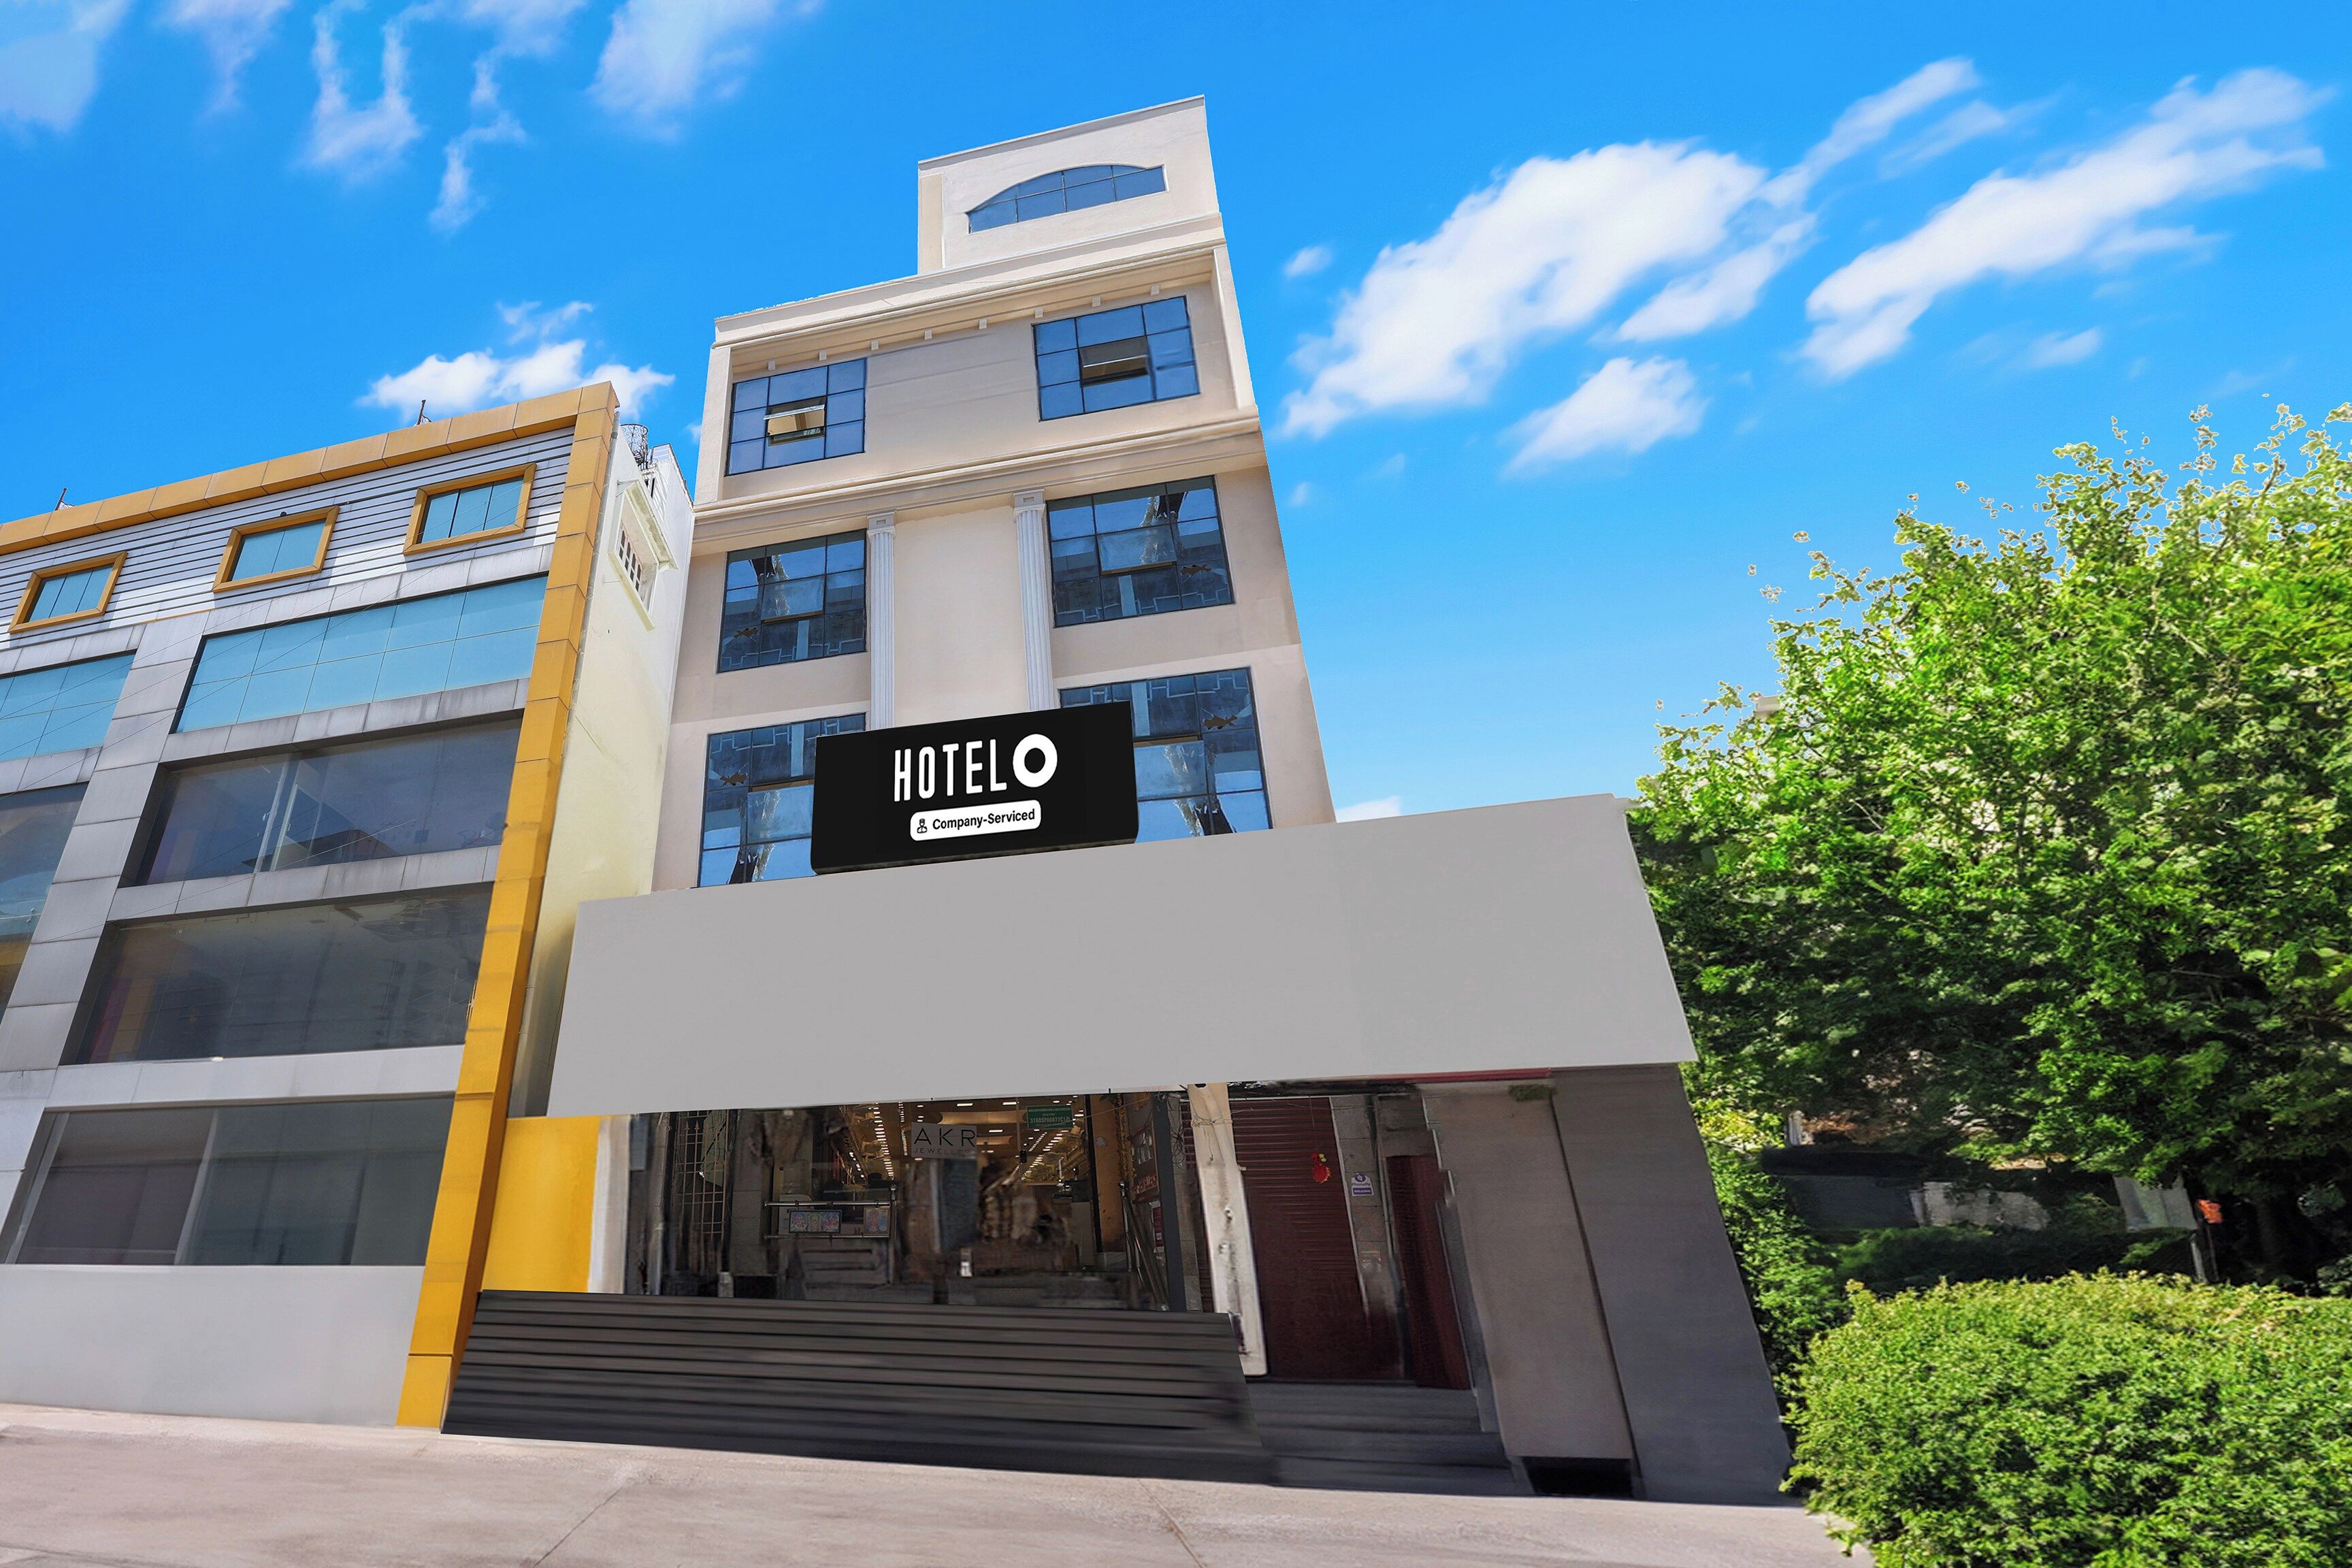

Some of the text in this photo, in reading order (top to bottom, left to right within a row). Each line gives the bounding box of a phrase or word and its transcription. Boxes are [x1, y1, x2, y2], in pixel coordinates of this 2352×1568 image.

[894, 734, 1058, 802] HOTEL O
[932, 808, 1035, 830] Company-Serviced
[913, 1128, 975, 1147] AKR
